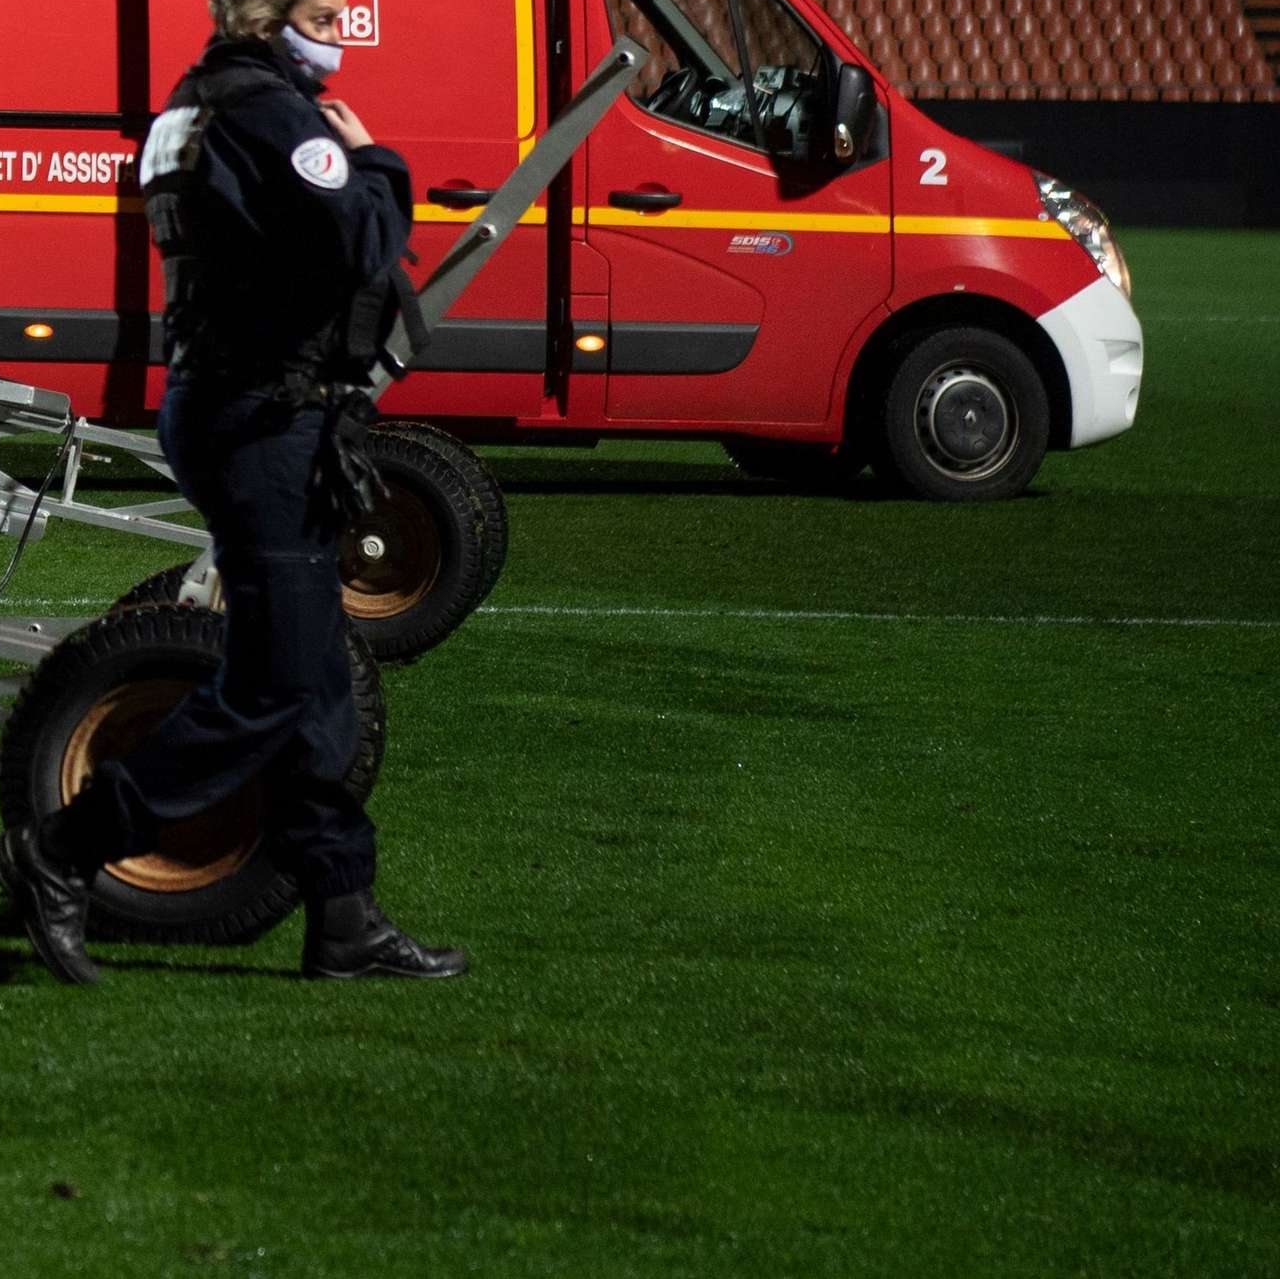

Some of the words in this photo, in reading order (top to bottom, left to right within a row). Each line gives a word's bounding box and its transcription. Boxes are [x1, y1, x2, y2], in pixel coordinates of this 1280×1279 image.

[336, 6, 373, 38] 18
[21, 151, 42, 182] D'
[919, 147, 948, 186] 2
